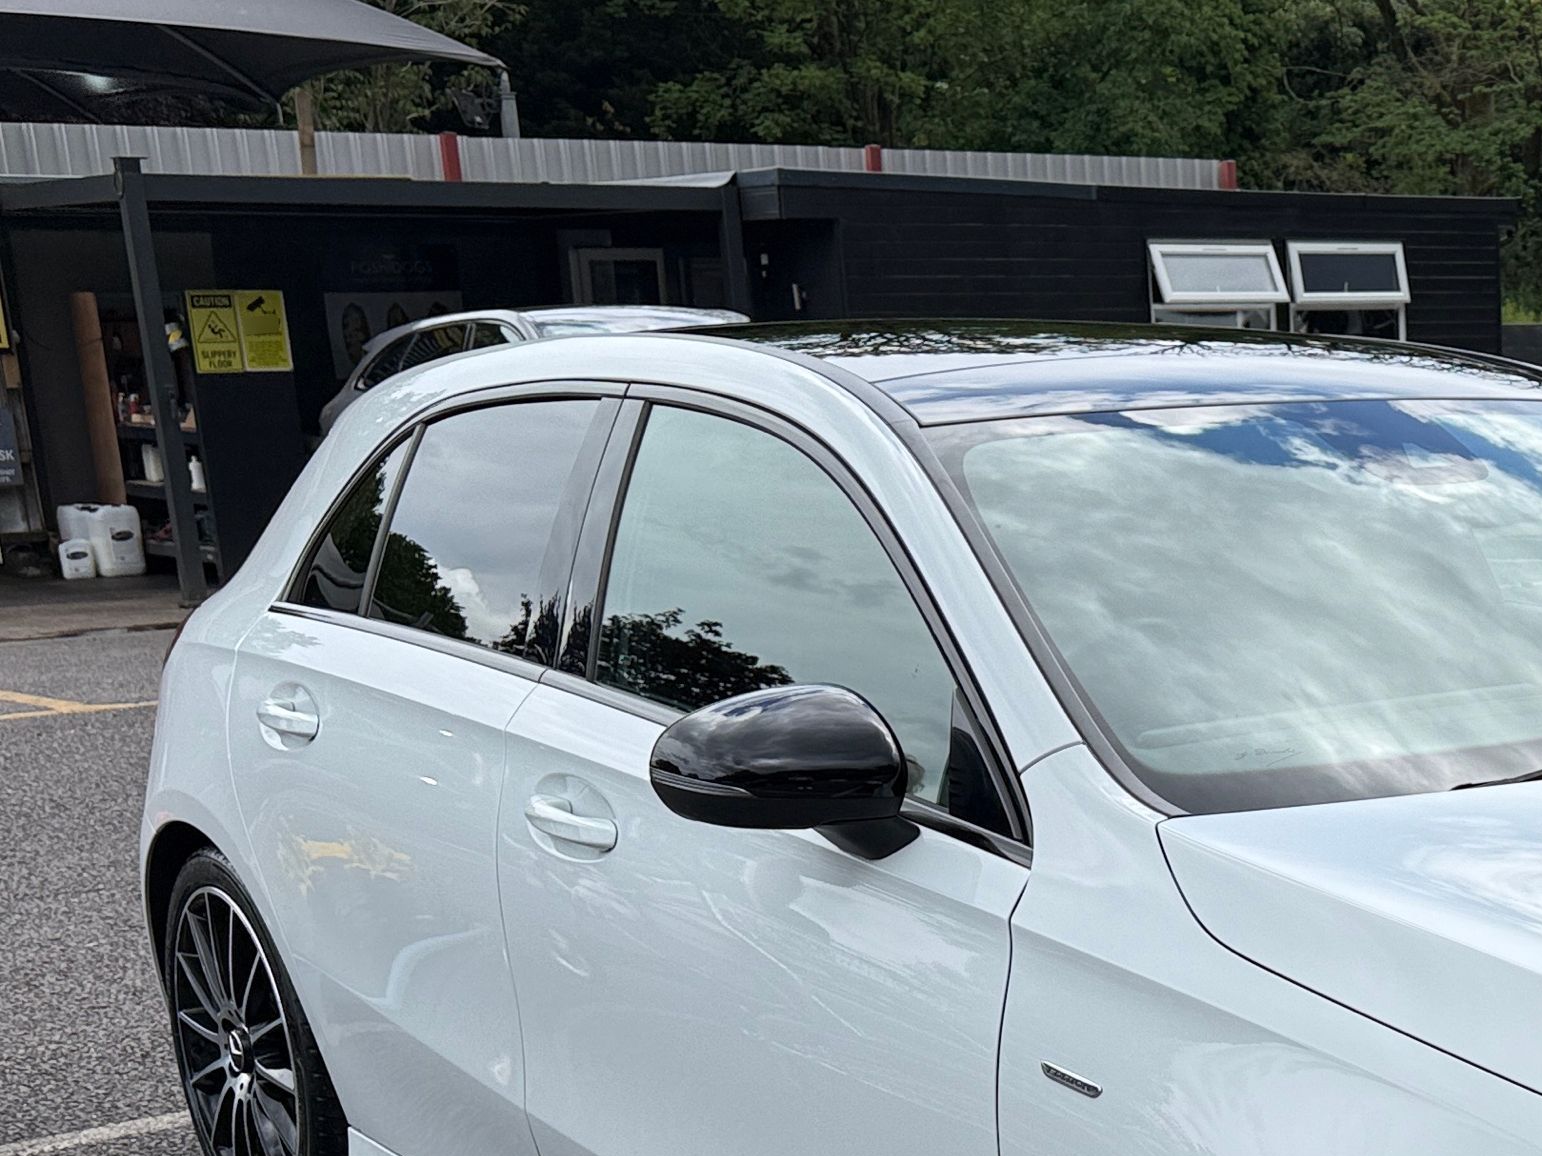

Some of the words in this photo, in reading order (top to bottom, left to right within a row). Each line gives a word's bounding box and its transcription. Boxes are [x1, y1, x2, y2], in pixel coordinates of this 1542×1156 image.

[192, 296, 230, 307] CAUTION
[201, 350, 237, 359] SLIPPERY
[209, 360, 233, 369] FLOOR
[1048, 1069, 1090, 1092] EDITION
